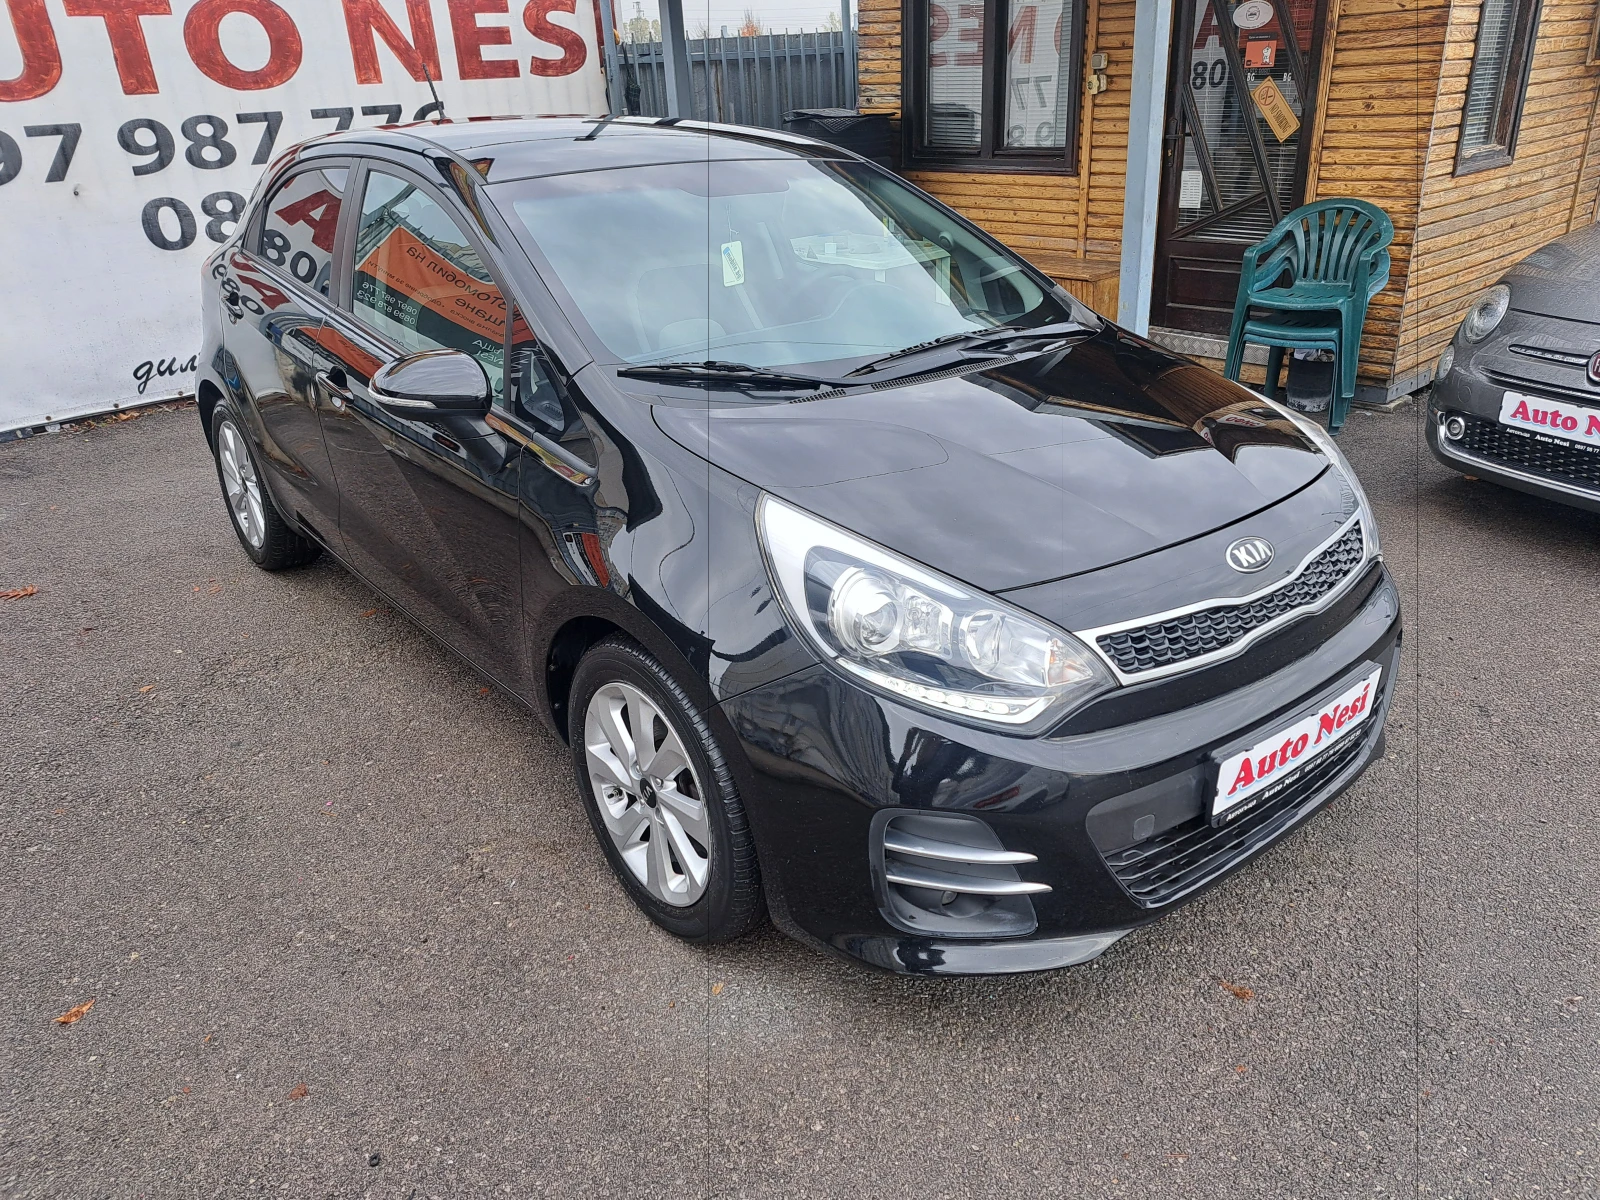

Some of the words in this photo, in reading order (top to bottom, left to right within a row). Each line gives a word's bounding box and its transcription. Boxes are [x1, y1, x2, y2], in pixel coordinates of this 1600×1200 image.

[117, 111, 283, 176] 987
[1510, 400, 1579, 432] Auto
[1535, 434, 1553, 443] Auto
[1553, 439, 1570, 448] Nesi
[1232, 540, 1272, 567] KIA
[1227, 735, 1309, 796] Auto
[1314, 683, 1370, 746] Nesi
[1262, 784, 1283, 800] Auto
